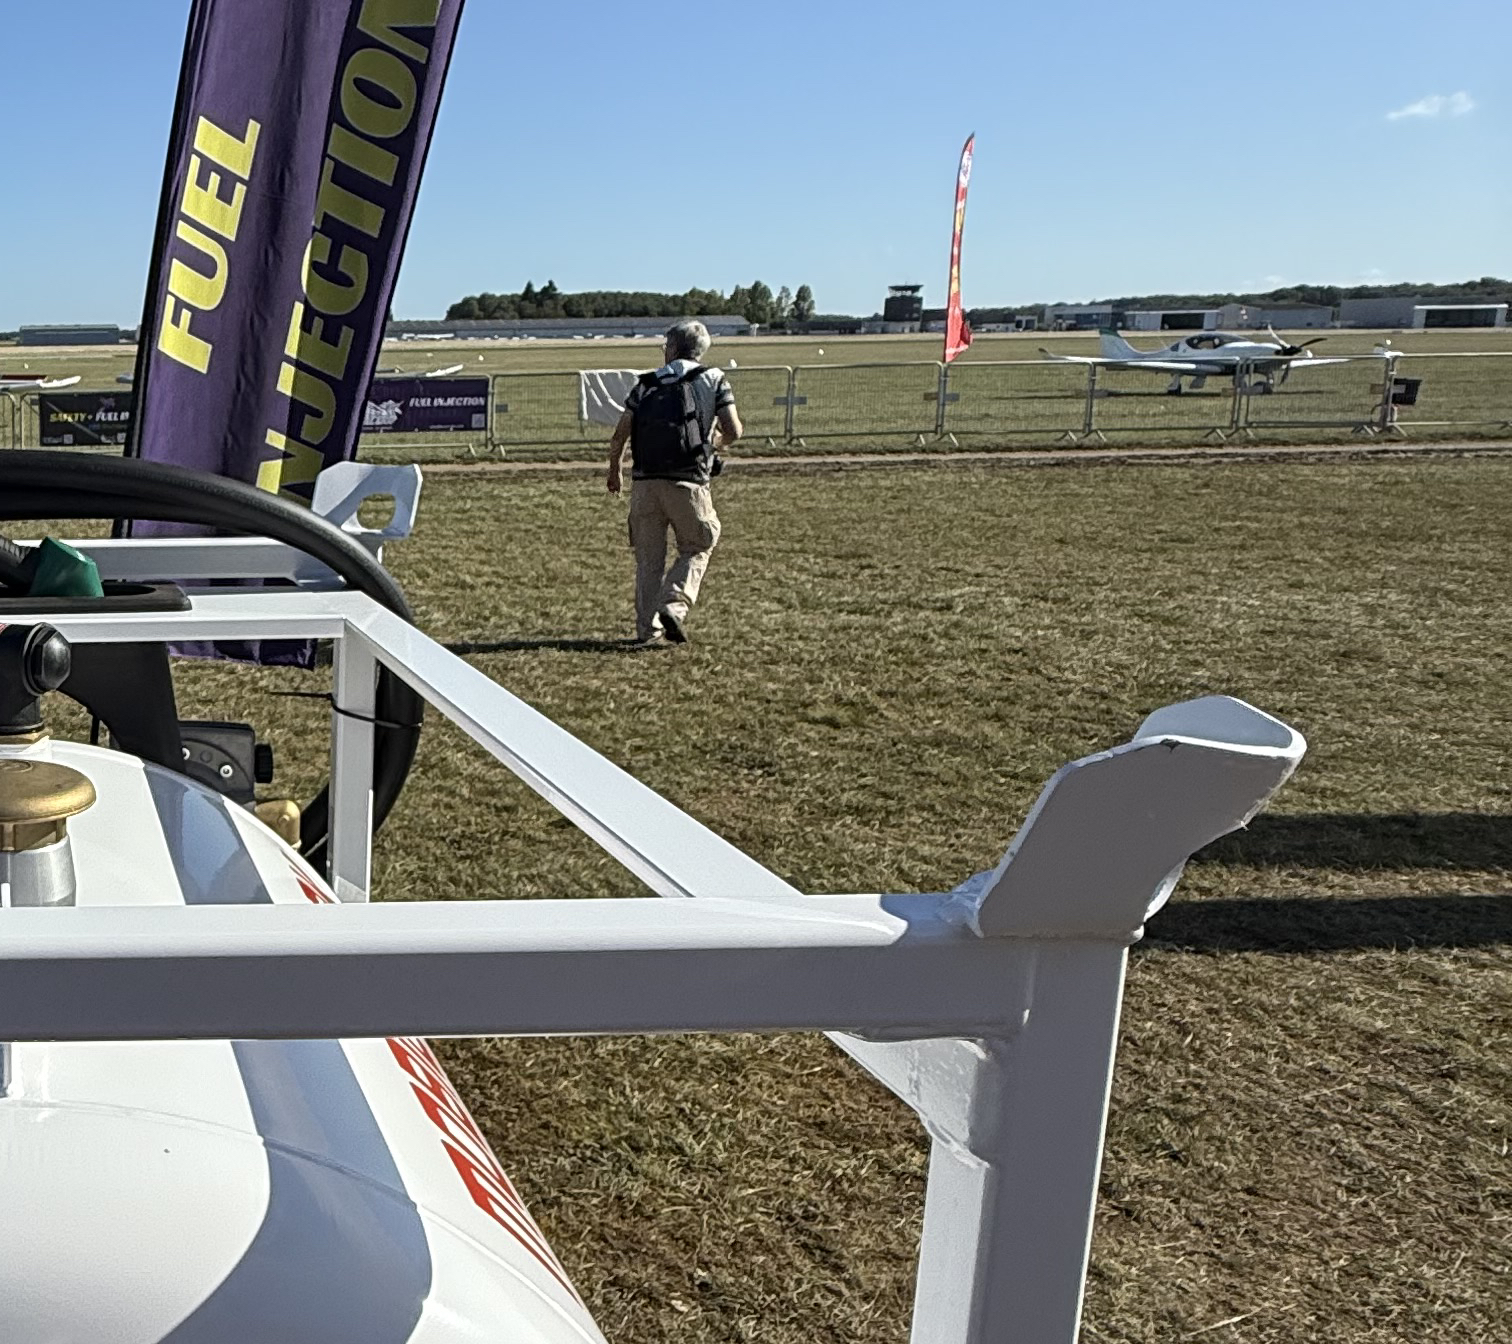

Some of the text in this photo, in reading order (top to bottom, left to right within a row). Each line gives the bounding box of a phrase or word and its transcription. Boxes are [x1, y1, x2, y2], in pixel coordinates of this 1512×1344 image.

[157, 115, 261, 374] FUEL
[409, 396, 486, 407] FUEL INJECTION
[95, 411, 119, 422] FUEL
